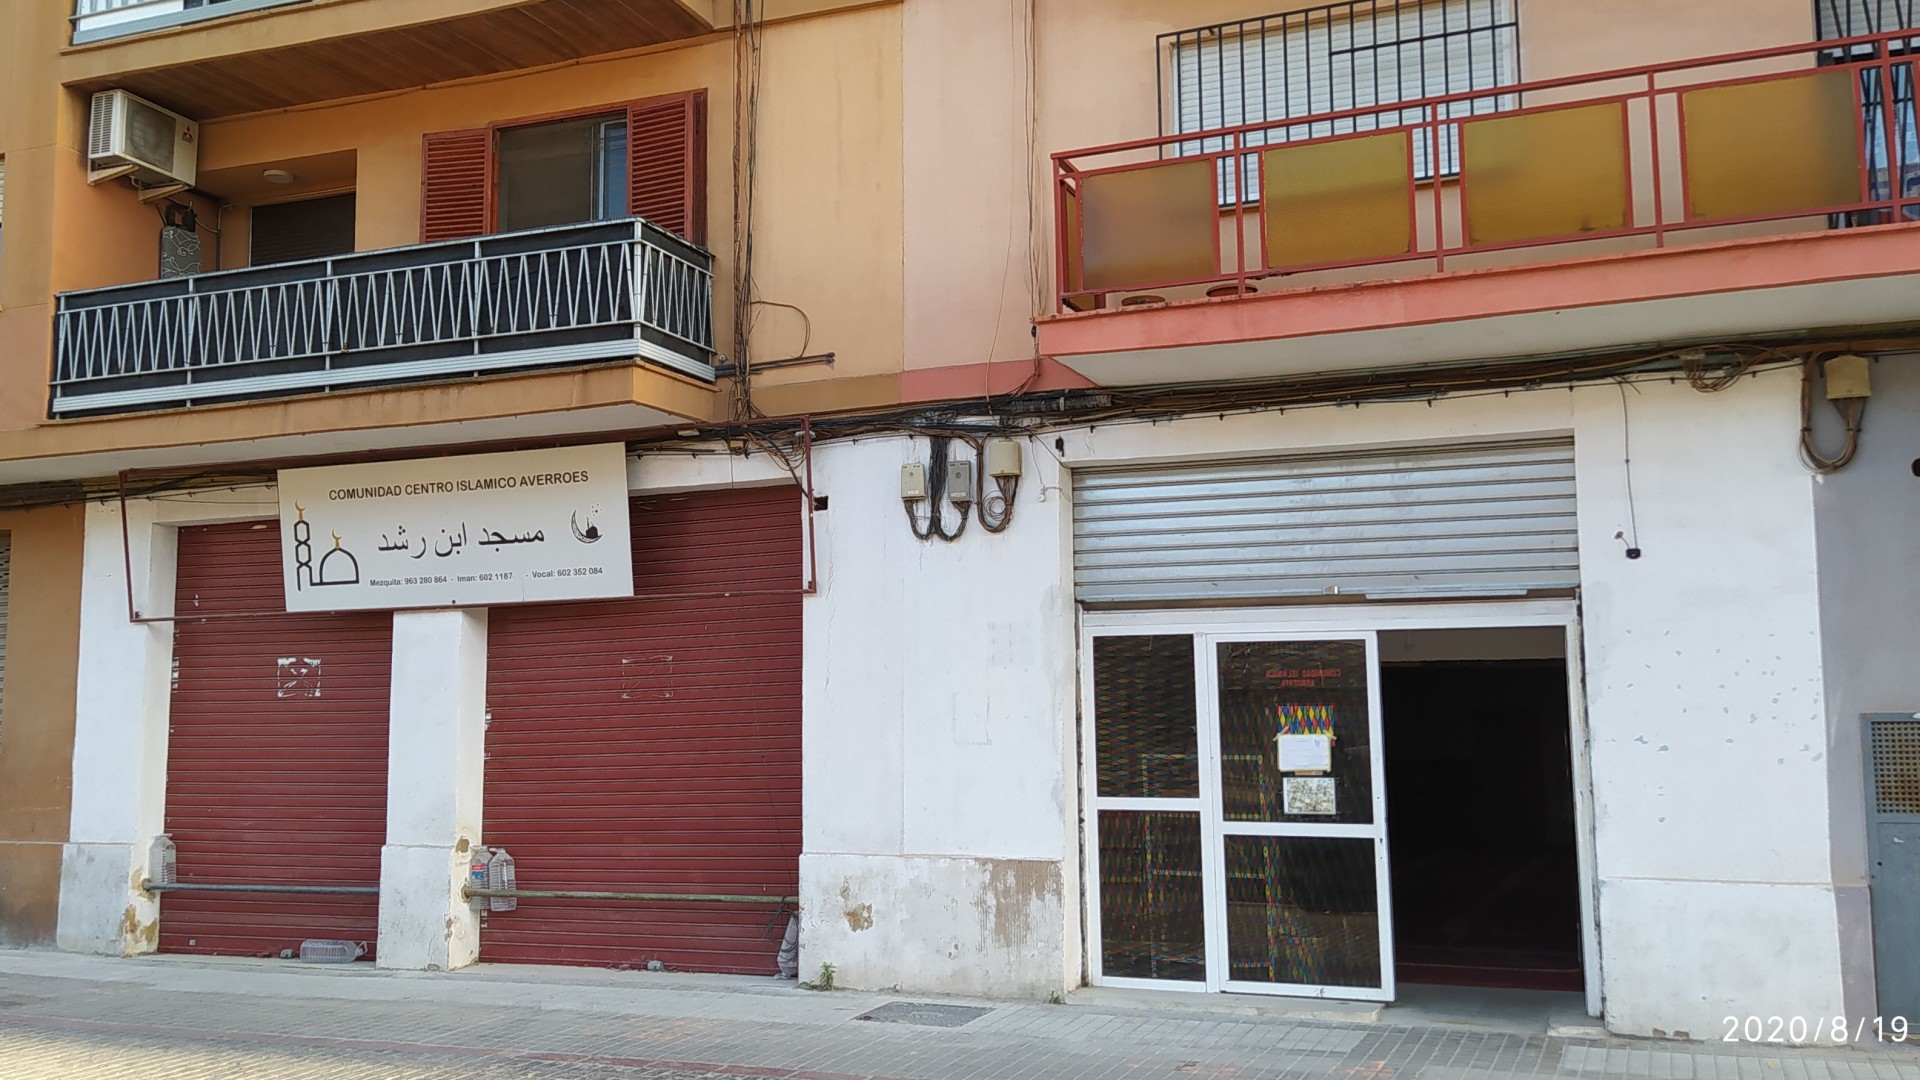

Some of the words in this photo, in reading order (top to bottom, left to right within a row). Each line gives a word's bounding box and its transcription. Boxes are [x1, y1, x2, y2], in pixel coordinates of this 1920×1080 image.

[329, 485, 402, 501] COMUNIDAD
[405, 482, 454, 496] CENTRO
[456, 477, 517, 492] ISLAMICO
[519, 470, 589, 487] AVERROES
[377, 525, 427, 559] رشد
[434, 521, 467, 557] ابن
[478, 527, 545, 552] مسجد
[369, 578, 403, 588] Mezquita:
[404, 577, 418, 585] 963
[419, 576, 433, 585] 280
[434, 575, 447, 584] 864
[457, 574, 478, 583] Iman:
[479, 573, 493, 581] 602
[532, 570, 556, 578] Vocal:
[557, 569, 571, 577] 602
[573, 568, 587, 576] 352
[588, 567, 603, 575] 084
